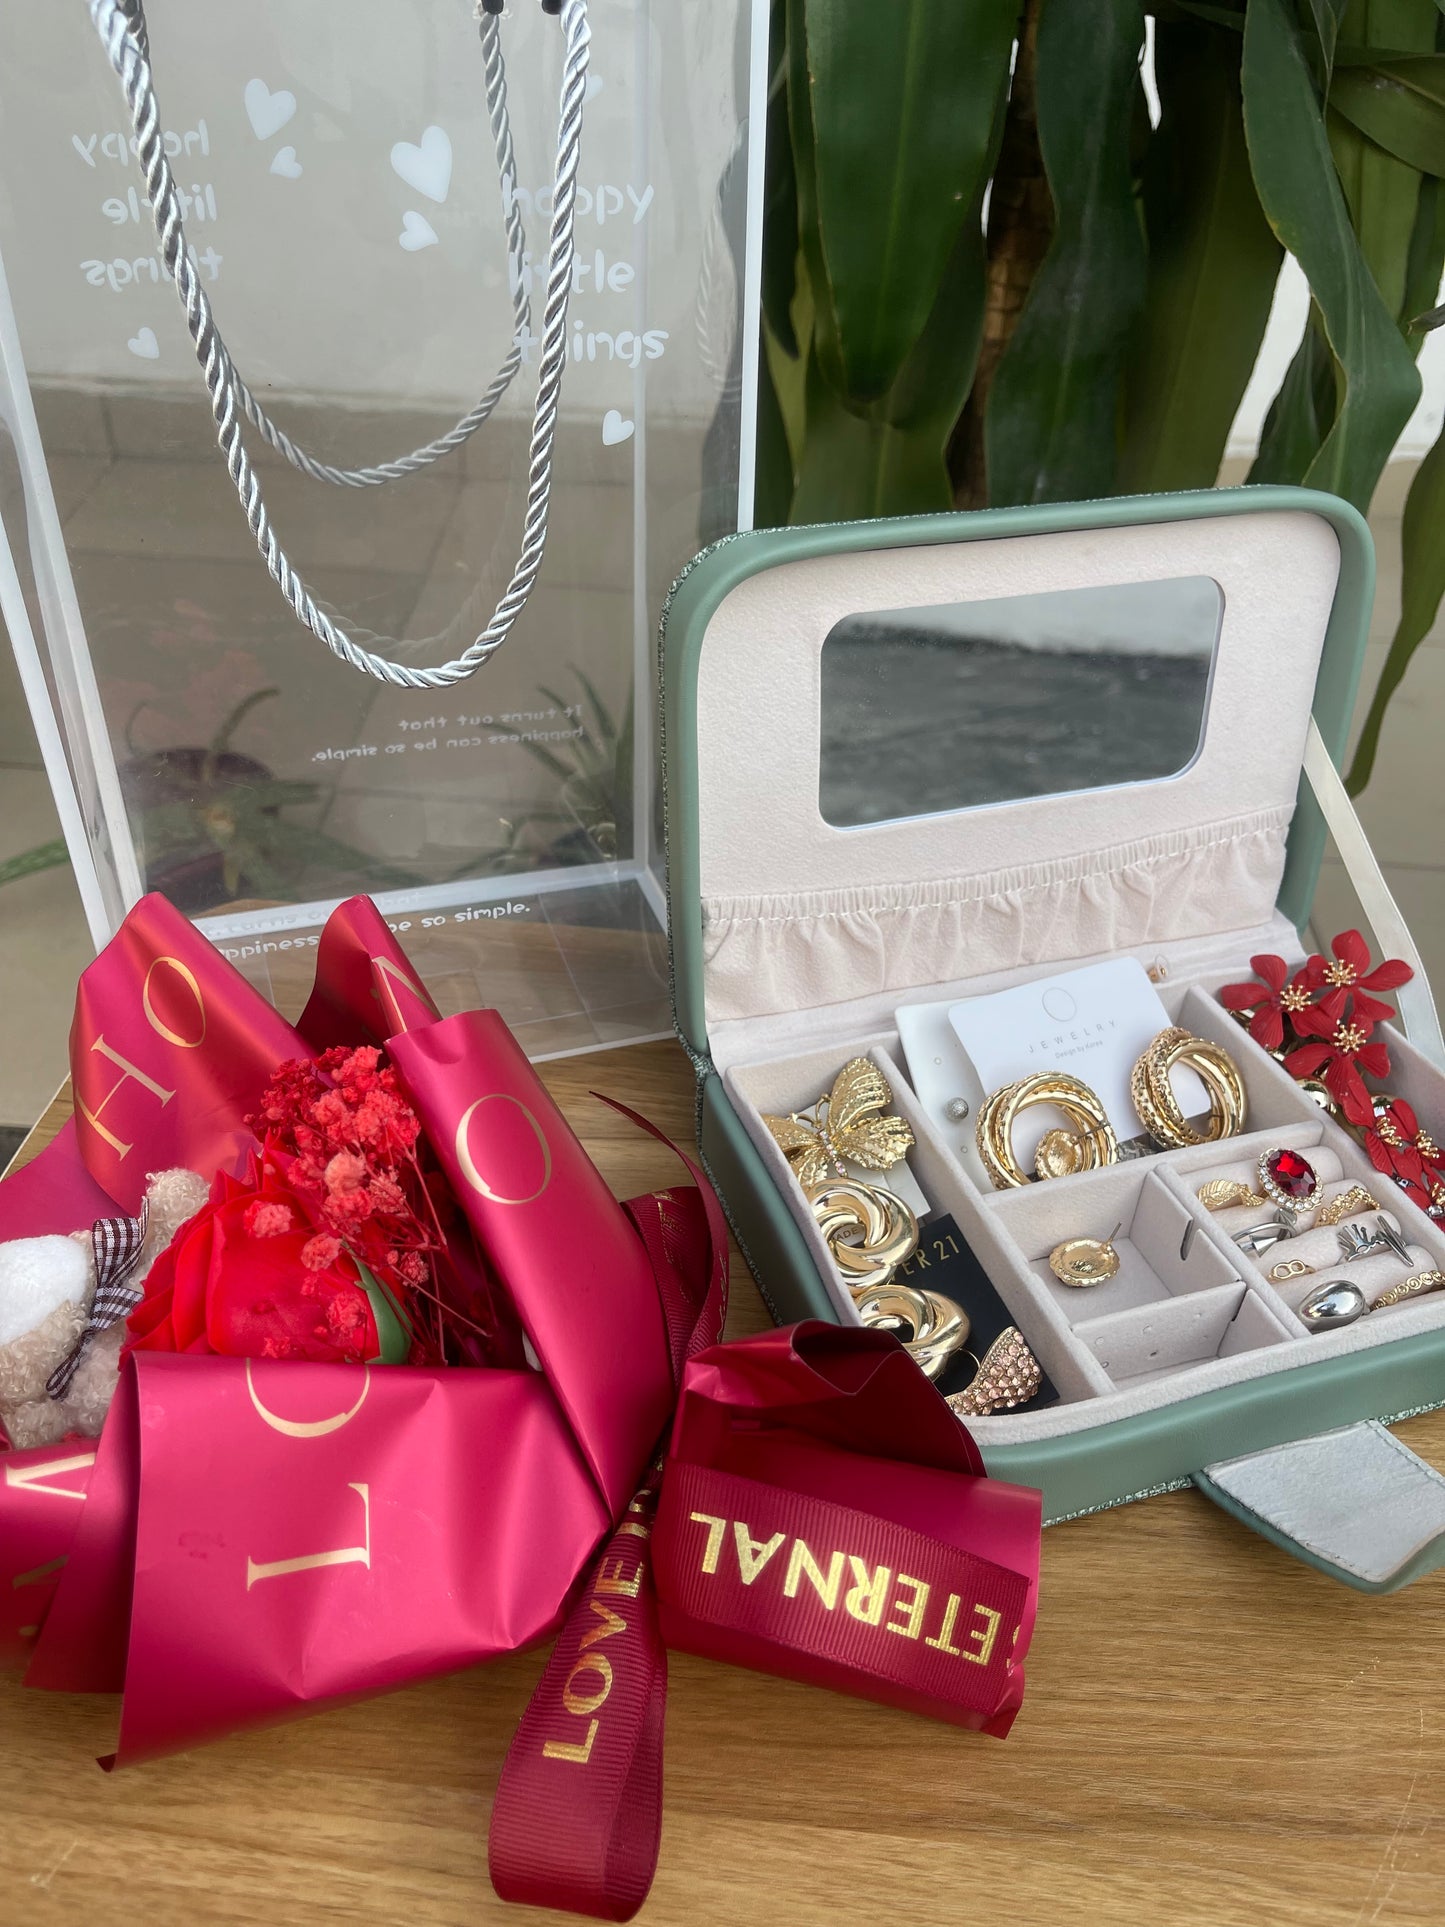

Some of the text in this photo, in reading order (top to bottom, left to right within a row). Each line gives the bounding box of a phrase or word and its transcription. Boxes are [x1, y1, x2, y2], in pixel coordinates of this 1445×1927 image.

[513, 320, 670, 369] tings
[421, 915, 447, 928] so
[454, 901, 531, 923] simple.
[1028, 1019, 1116, 1054] JEWELRY
[933, 1235, 960, 1261] 21
[690, 1511, 1002, 1666] ETERNAL
[542, 1556, 645, 1764] LOVE
